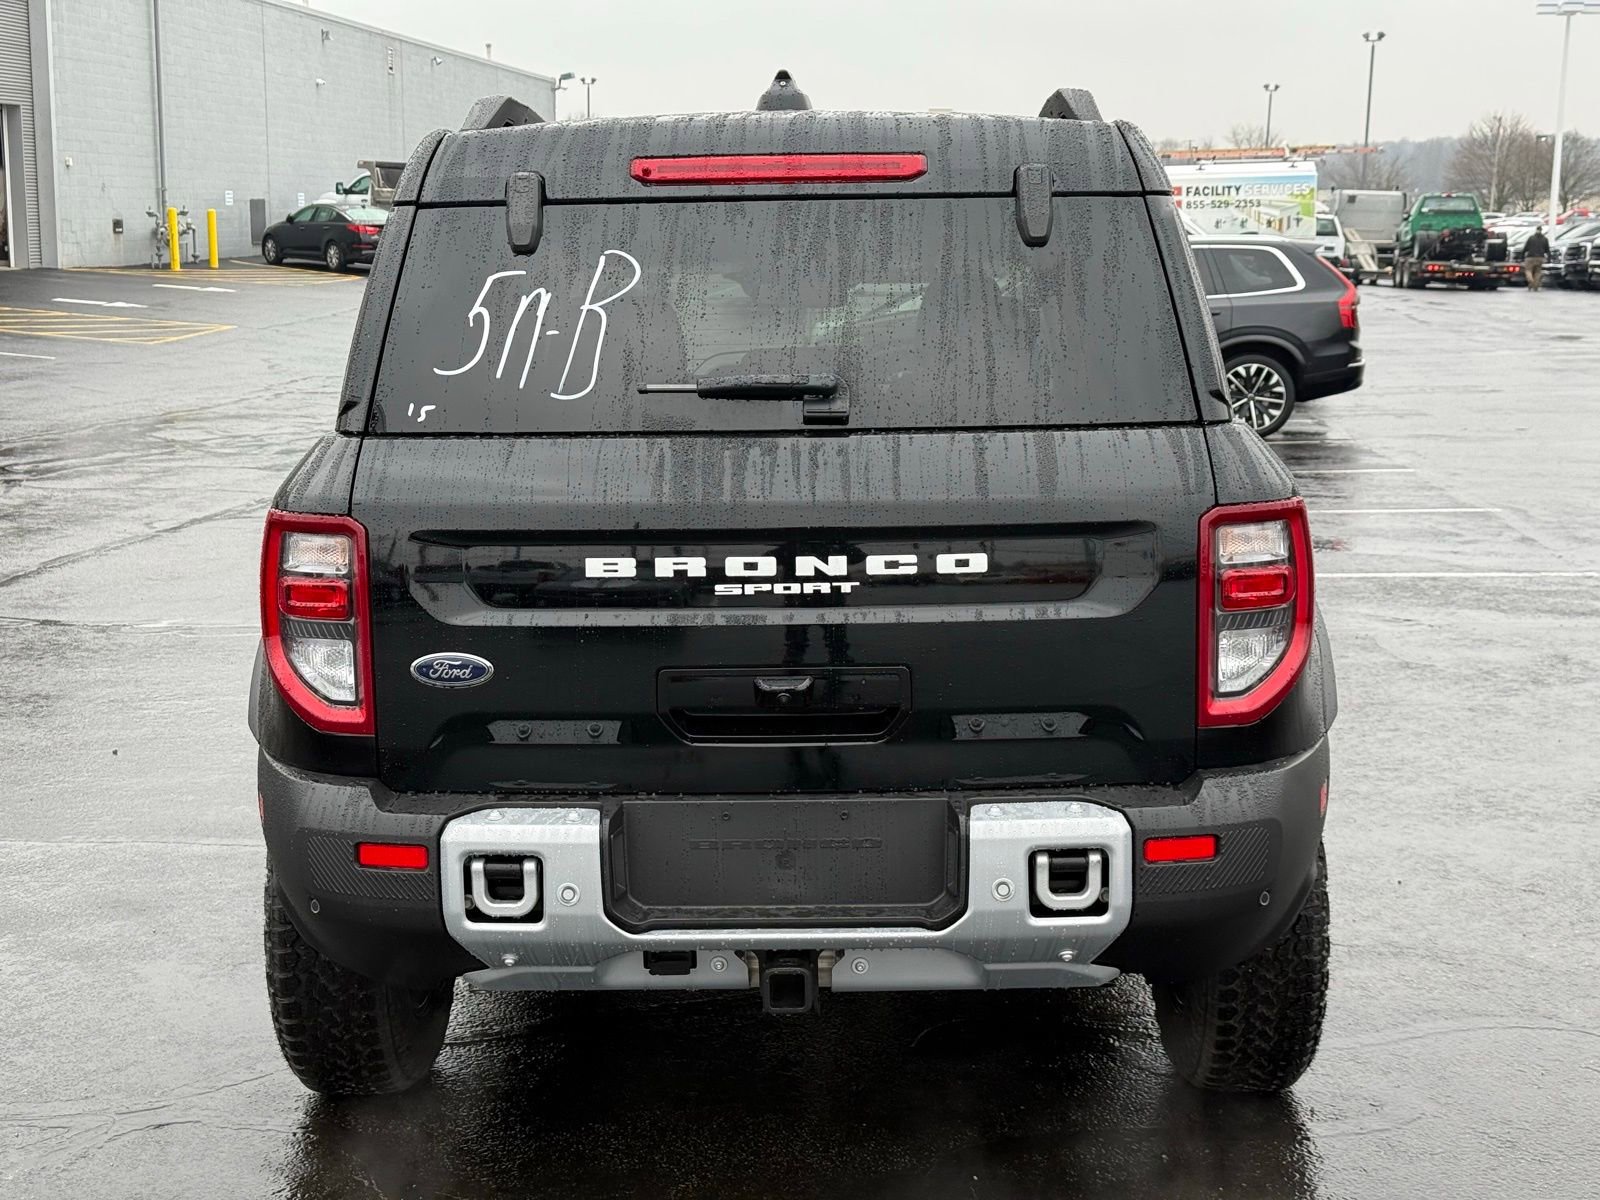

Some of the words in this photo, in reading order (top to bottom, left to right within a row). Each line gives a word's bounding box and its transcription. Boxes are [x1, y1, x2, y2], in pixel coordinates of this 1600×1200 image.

[1186, 184, 1242, 197] FACILITY
[1244, 183, 1312, 196] SERVICES
[1185, 199, 1262, 210] 855-529-2353
[584, 552, 989, 579] BRONCO
[714, 581, 860, 596] SPORT
[428, 659, 473, 679] Ford
